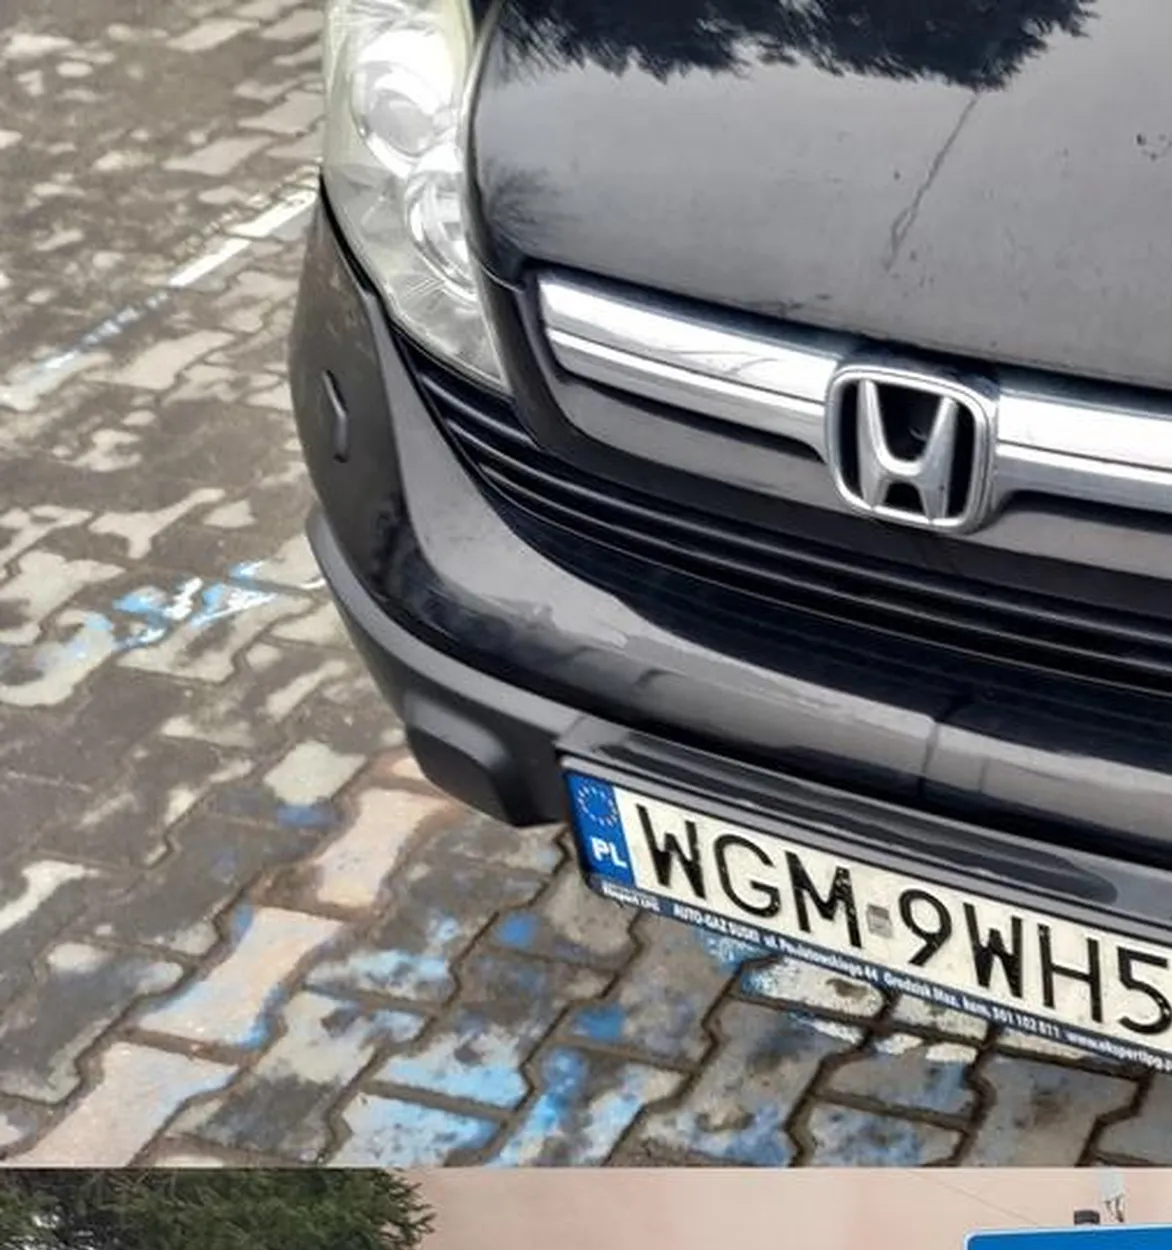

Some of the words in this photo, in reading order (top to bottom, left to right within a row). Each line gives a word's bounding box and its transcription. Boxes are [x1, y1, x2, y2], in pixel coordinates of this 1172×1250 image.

[592, 837, 626, 867] PL
[637, 804, 862, 948] WGM
[899, 890, 1172, 1034] 9WH5
